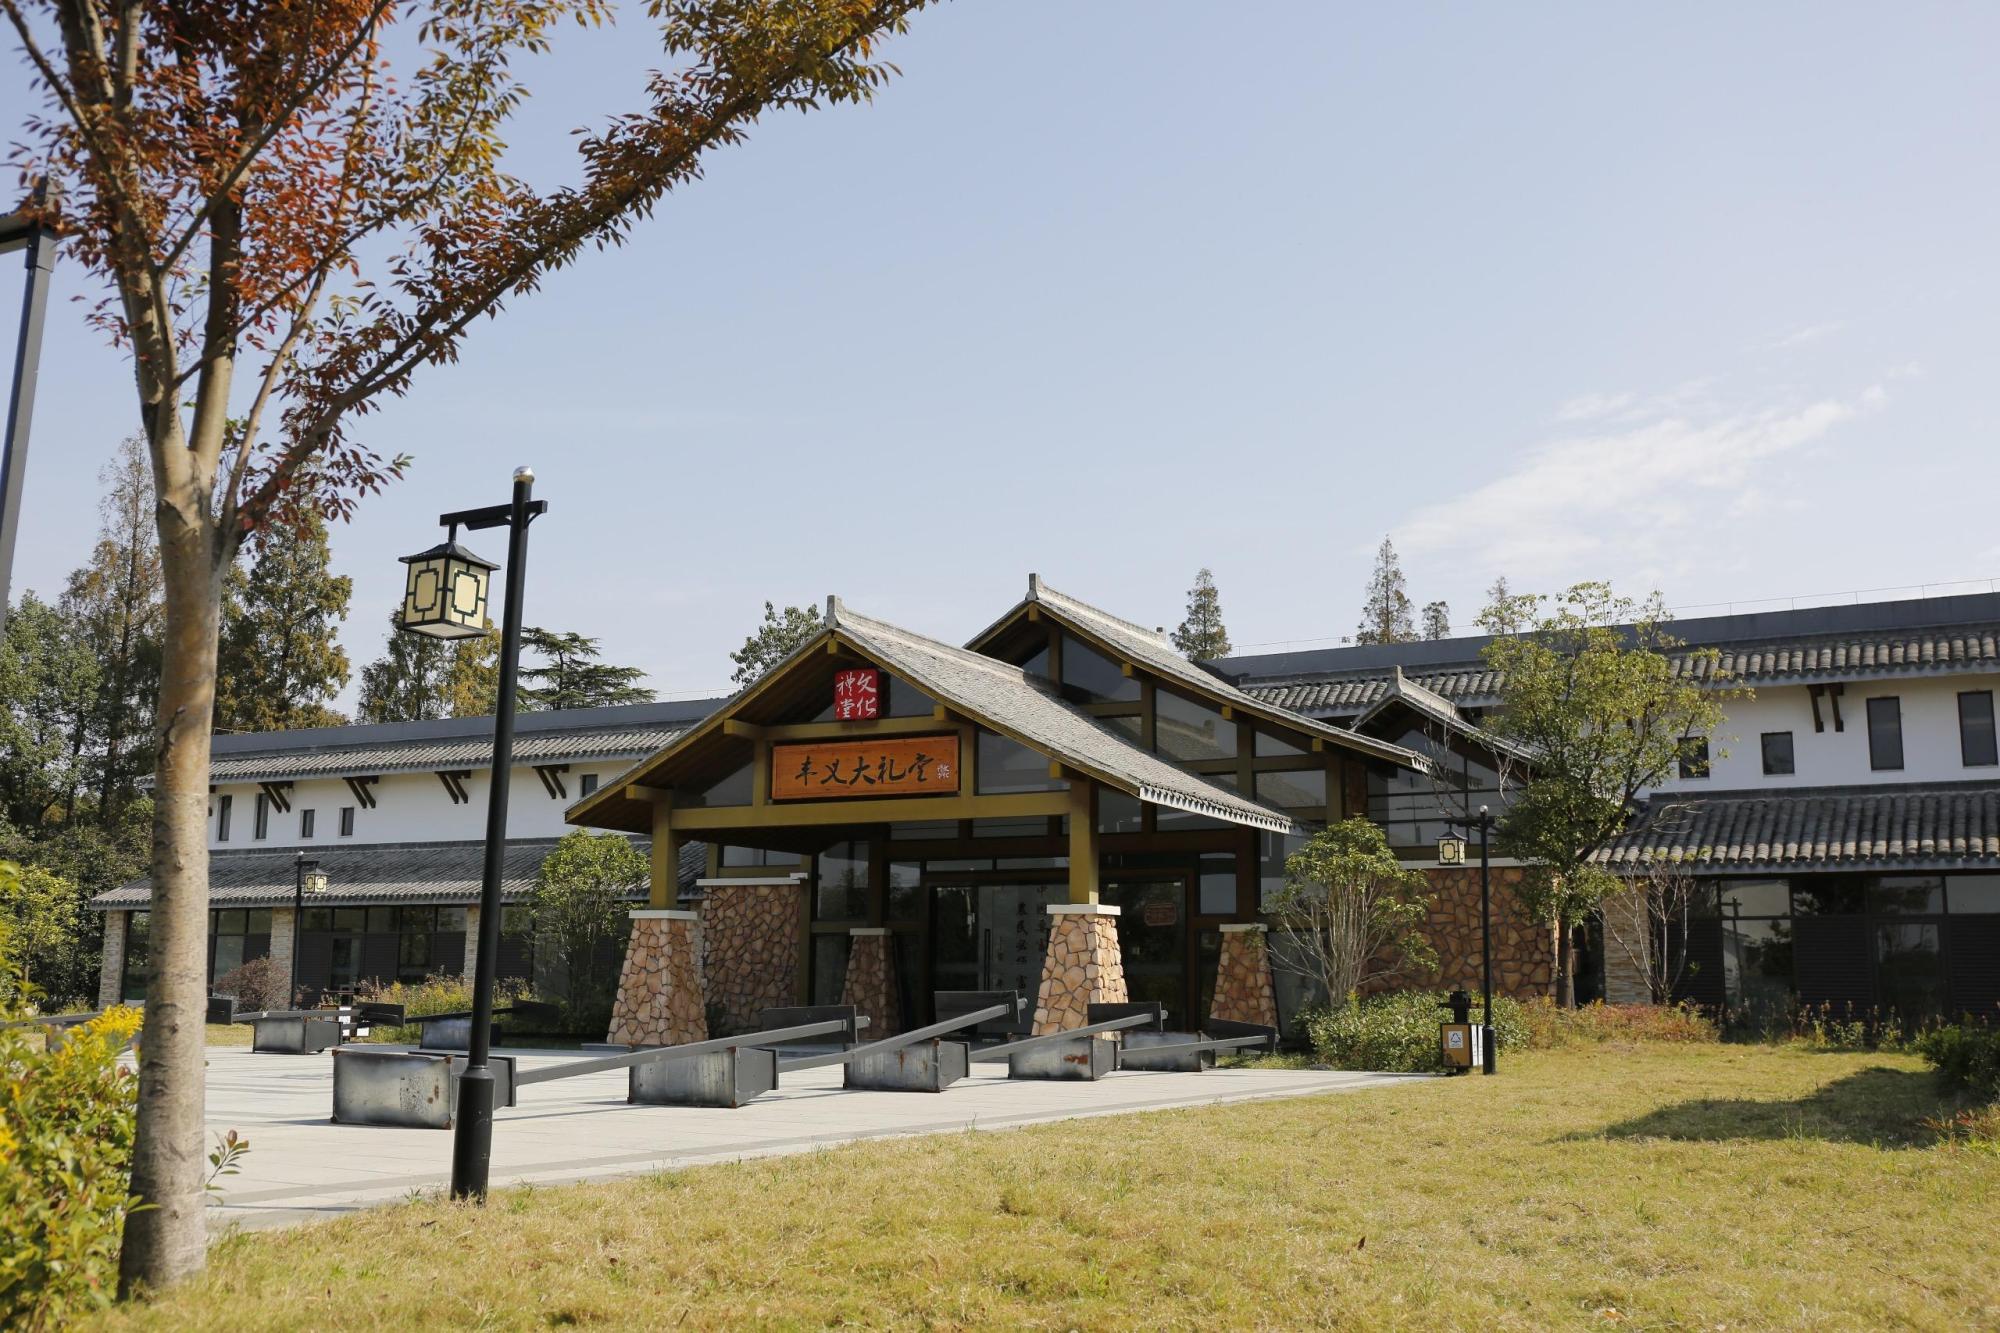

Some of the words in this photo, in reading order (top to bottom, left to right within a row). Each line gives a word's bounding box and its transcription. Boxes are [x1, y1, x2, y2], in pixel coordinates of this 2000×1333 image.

[795, 752, 935, 786] 丰义大礼堂
